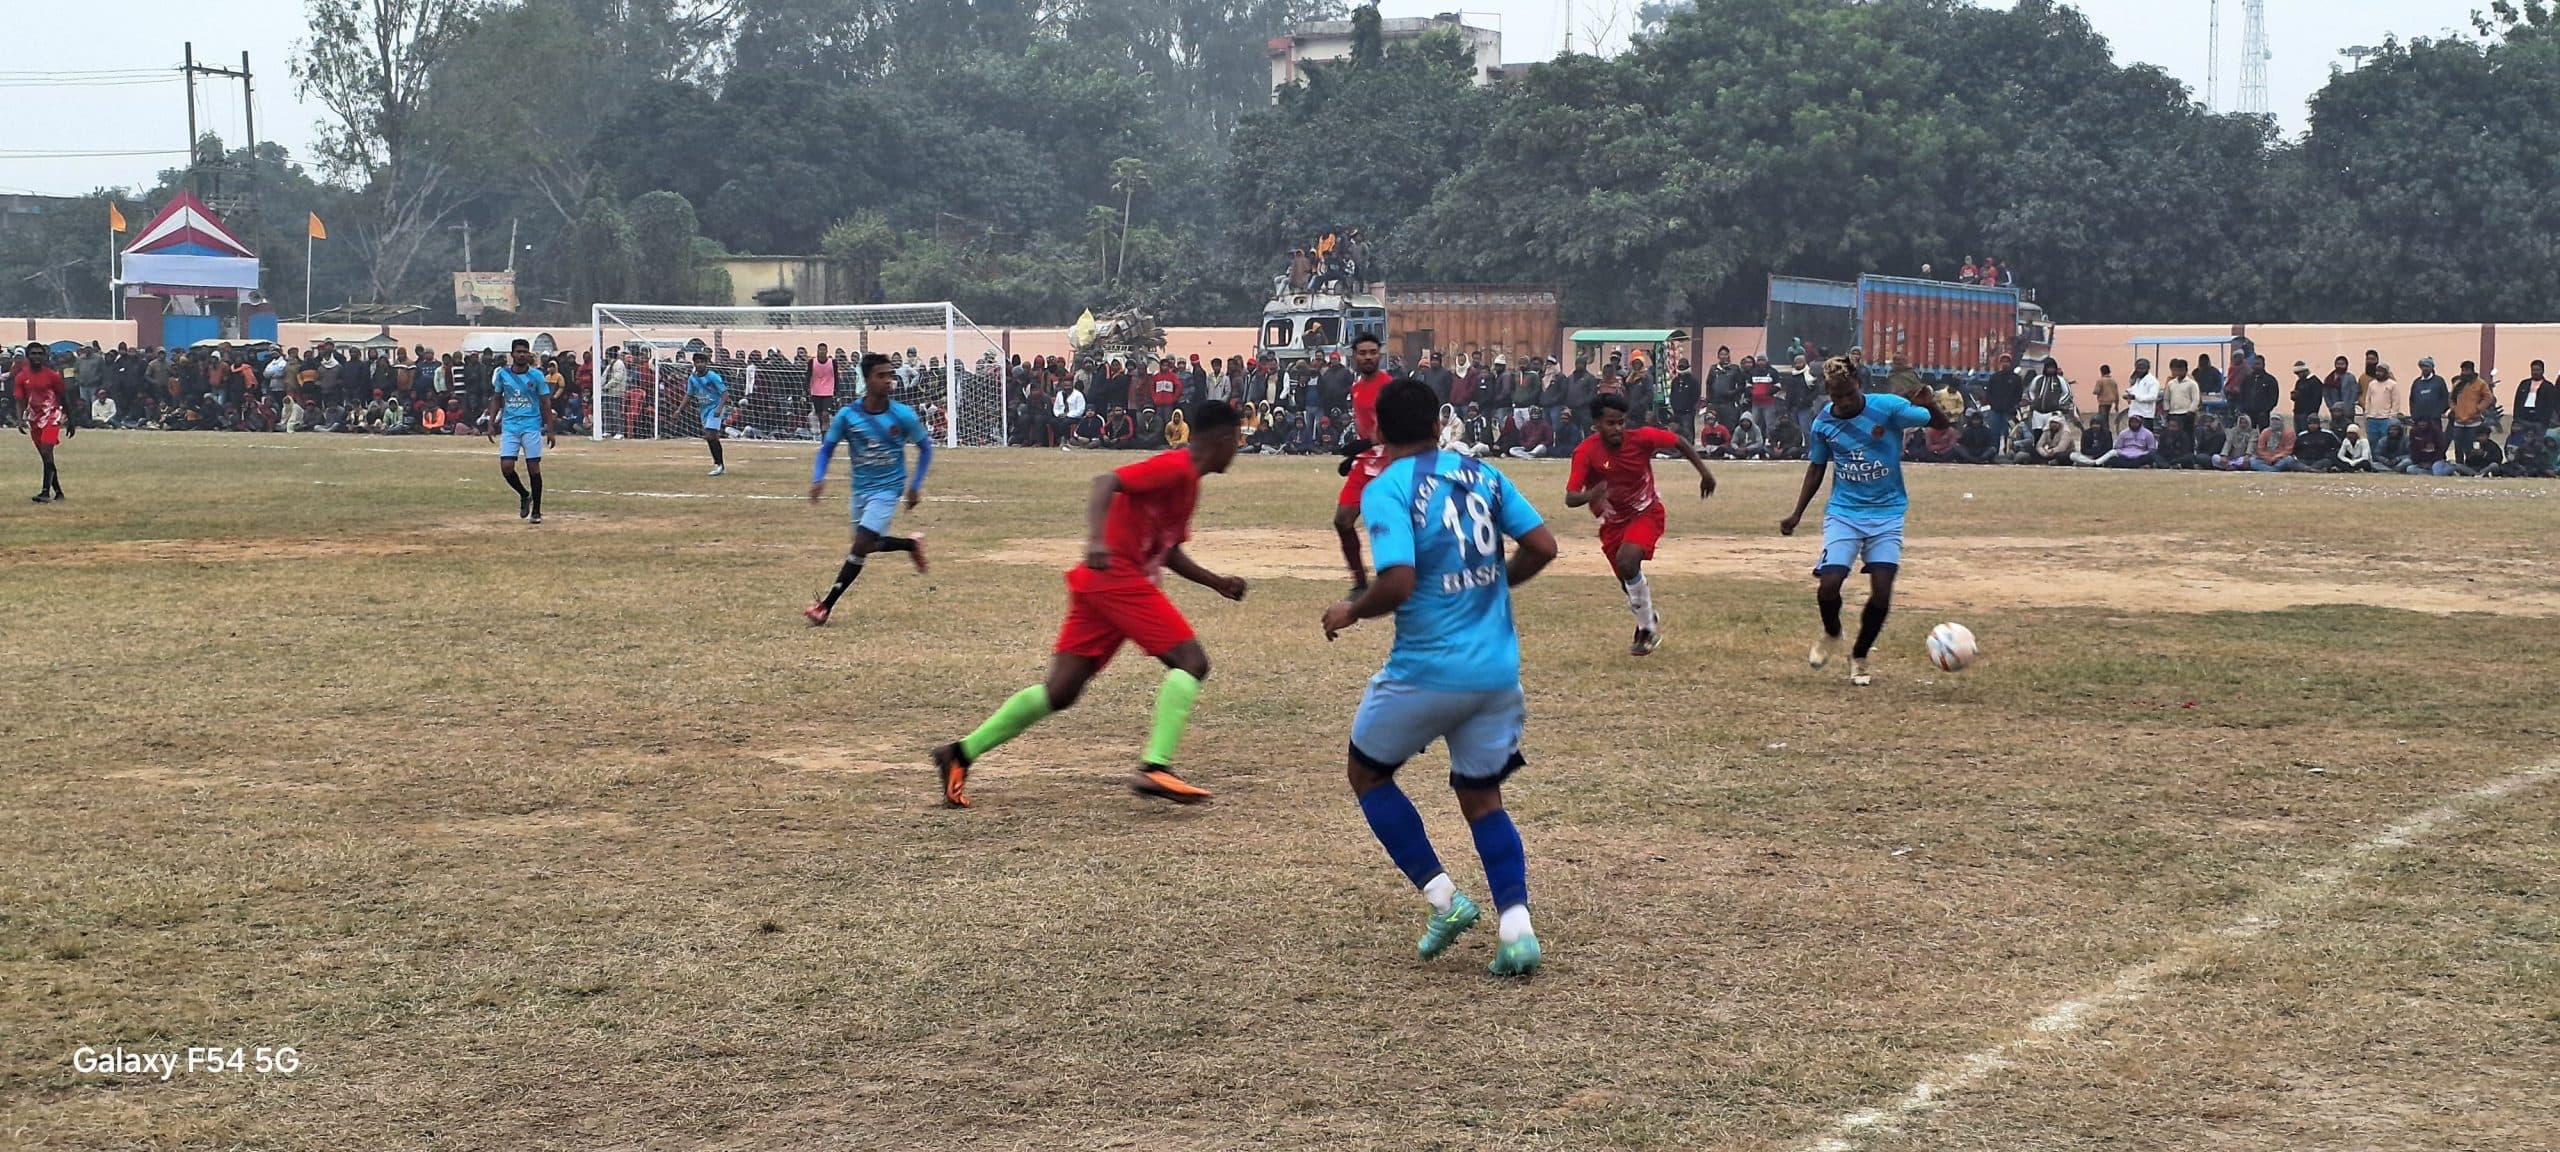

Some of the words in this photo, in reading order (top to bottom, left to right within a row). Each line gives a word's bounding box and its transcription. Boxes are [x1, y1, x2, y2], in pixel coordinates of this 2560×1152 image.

[1850, 449, 1864, 460] 12
[1842, 460, 1882, 472] JAGA
[1838, 468, 1889, 481] UNITED
[1441, 491, 1497, 560] 18
